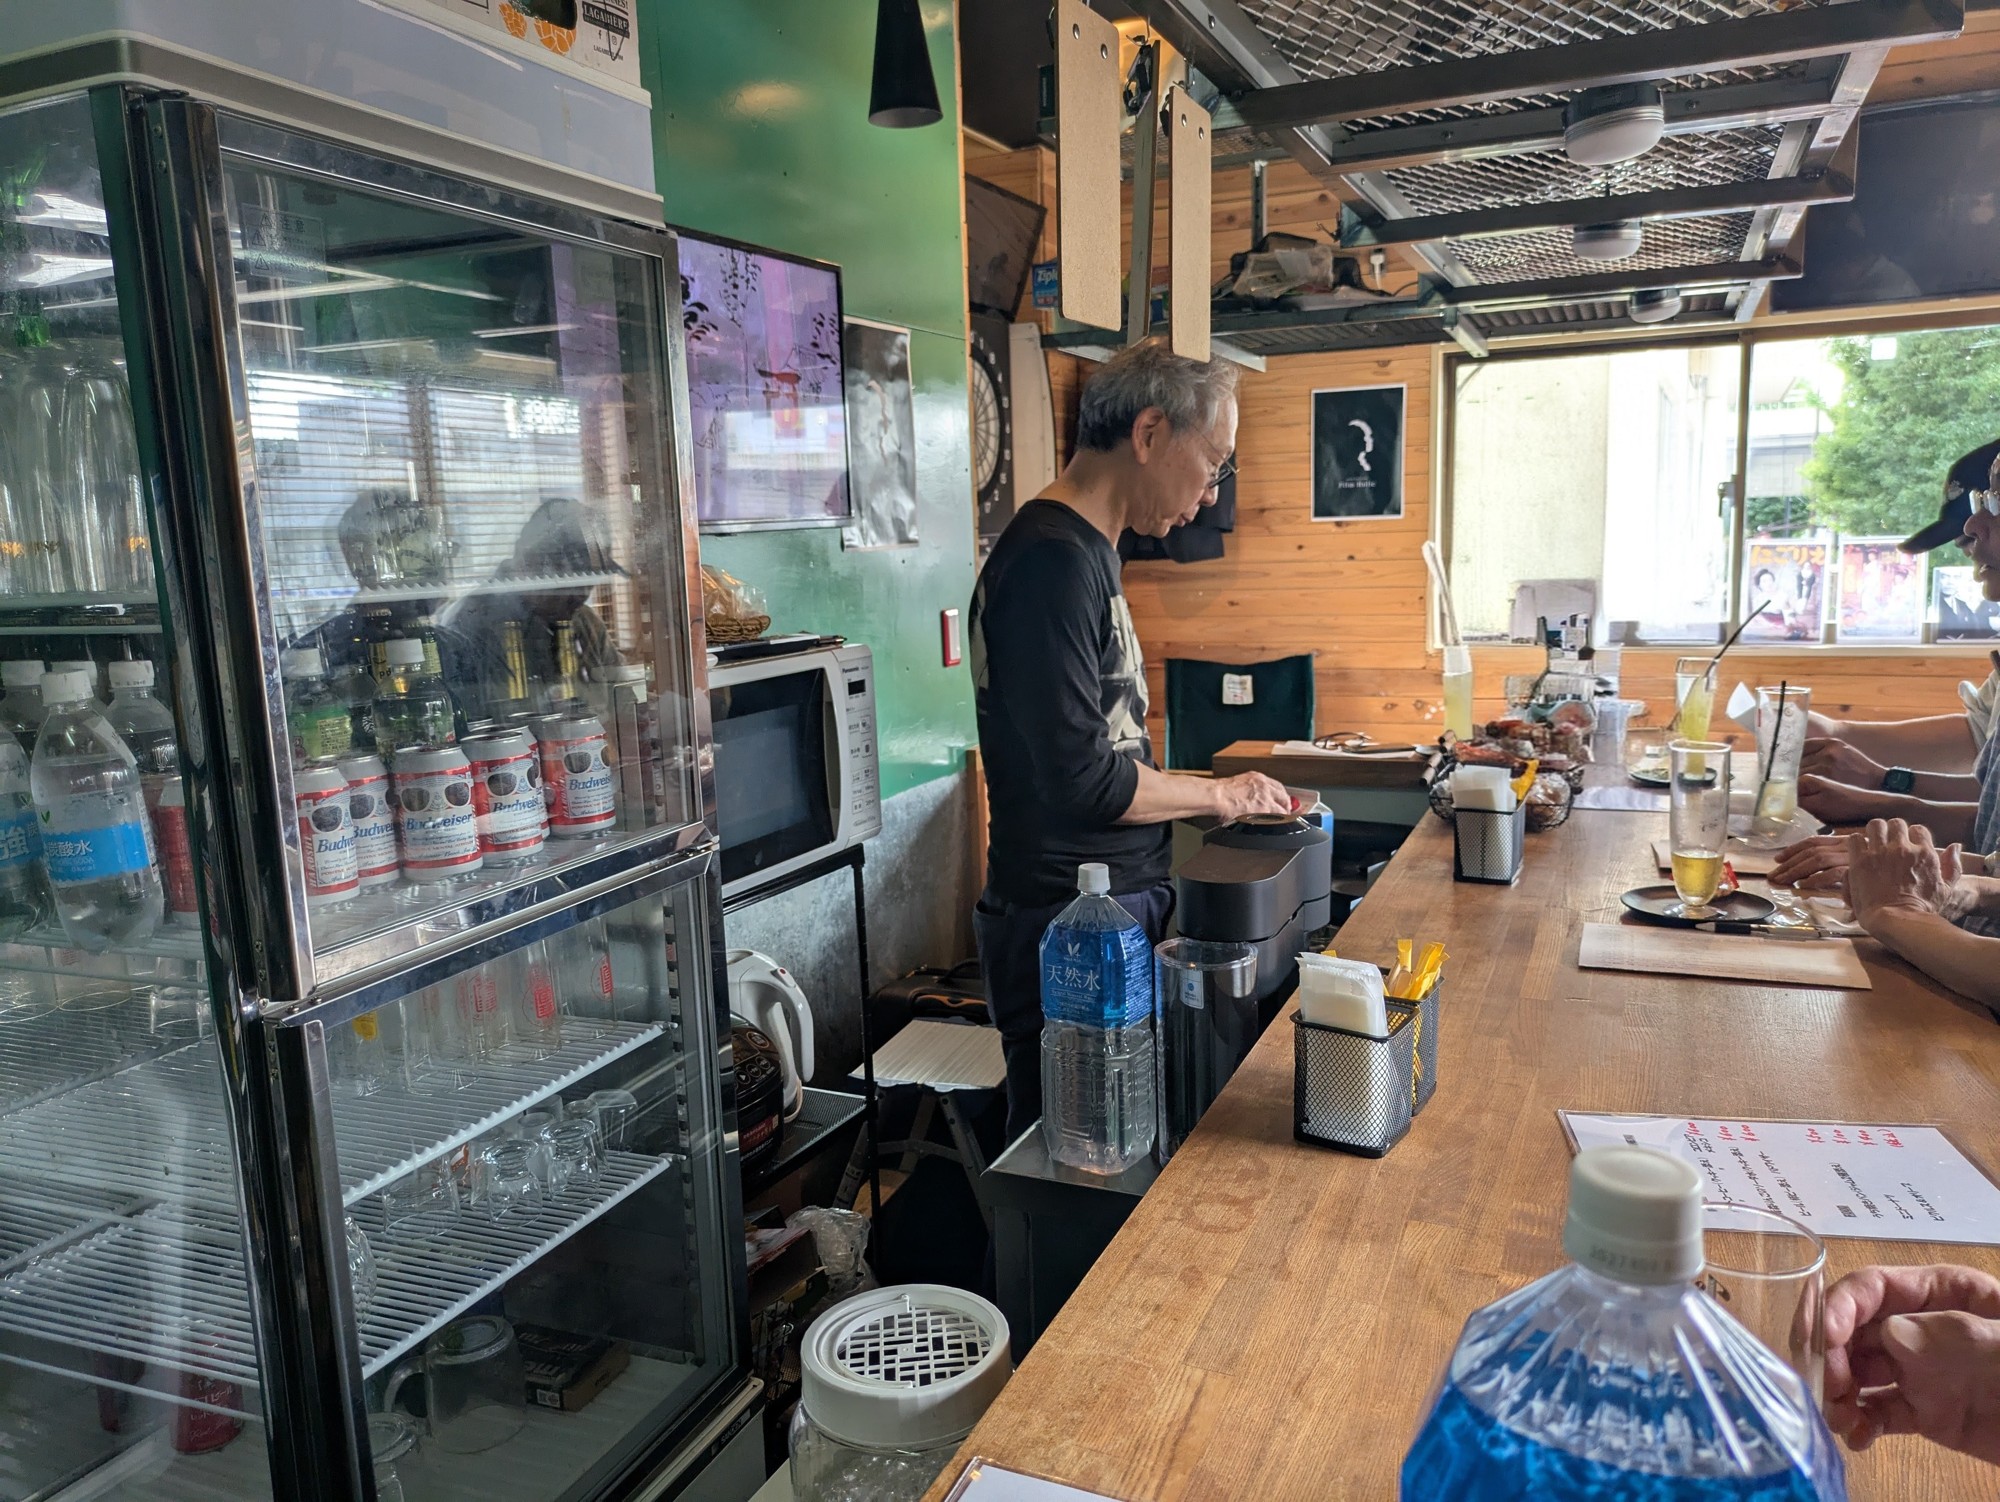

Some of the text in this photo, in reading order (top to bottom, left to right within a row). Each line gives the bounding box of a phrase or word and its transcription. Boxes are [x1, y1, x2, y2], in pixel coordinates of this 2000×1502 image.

[406, 813, 472, 830] Budweiser
[1046, 963, 1101, 991] 天然水
[1717, 1125, 1737, 1141] ¥600
[1740, 1124, 1761, 1142] ¥600
[1805, 1128, 1826, 1143] ¥500
[1883, 1193, 1915, 1221] ミニドーナツ
